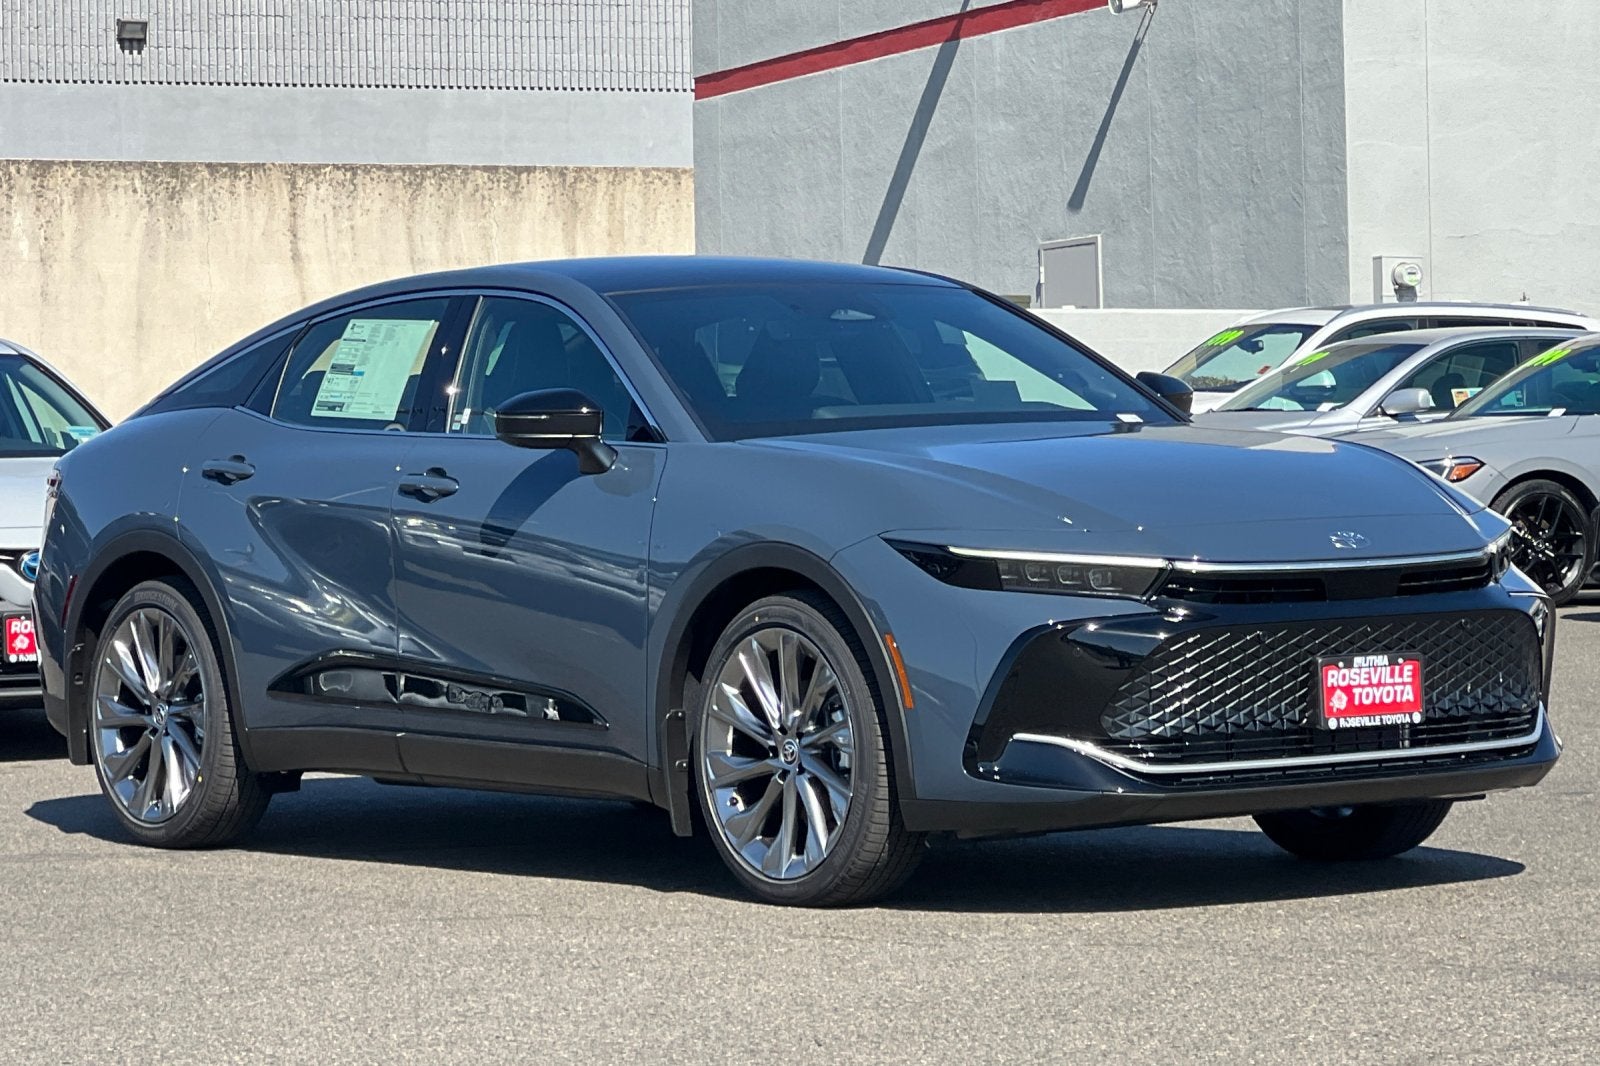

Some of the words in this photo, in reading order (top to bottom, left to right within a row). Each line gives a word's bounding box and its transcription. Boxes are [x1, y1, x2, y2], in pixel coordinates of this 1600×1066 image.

[1327, 665, 1413, 687] ROSEVILLE
[1352, 685, 1415, 705] TOYOTA
[1339, 714, 1381, 728] ROSEVILLE
[1382, 713, 1410, 725] TOYOTA
